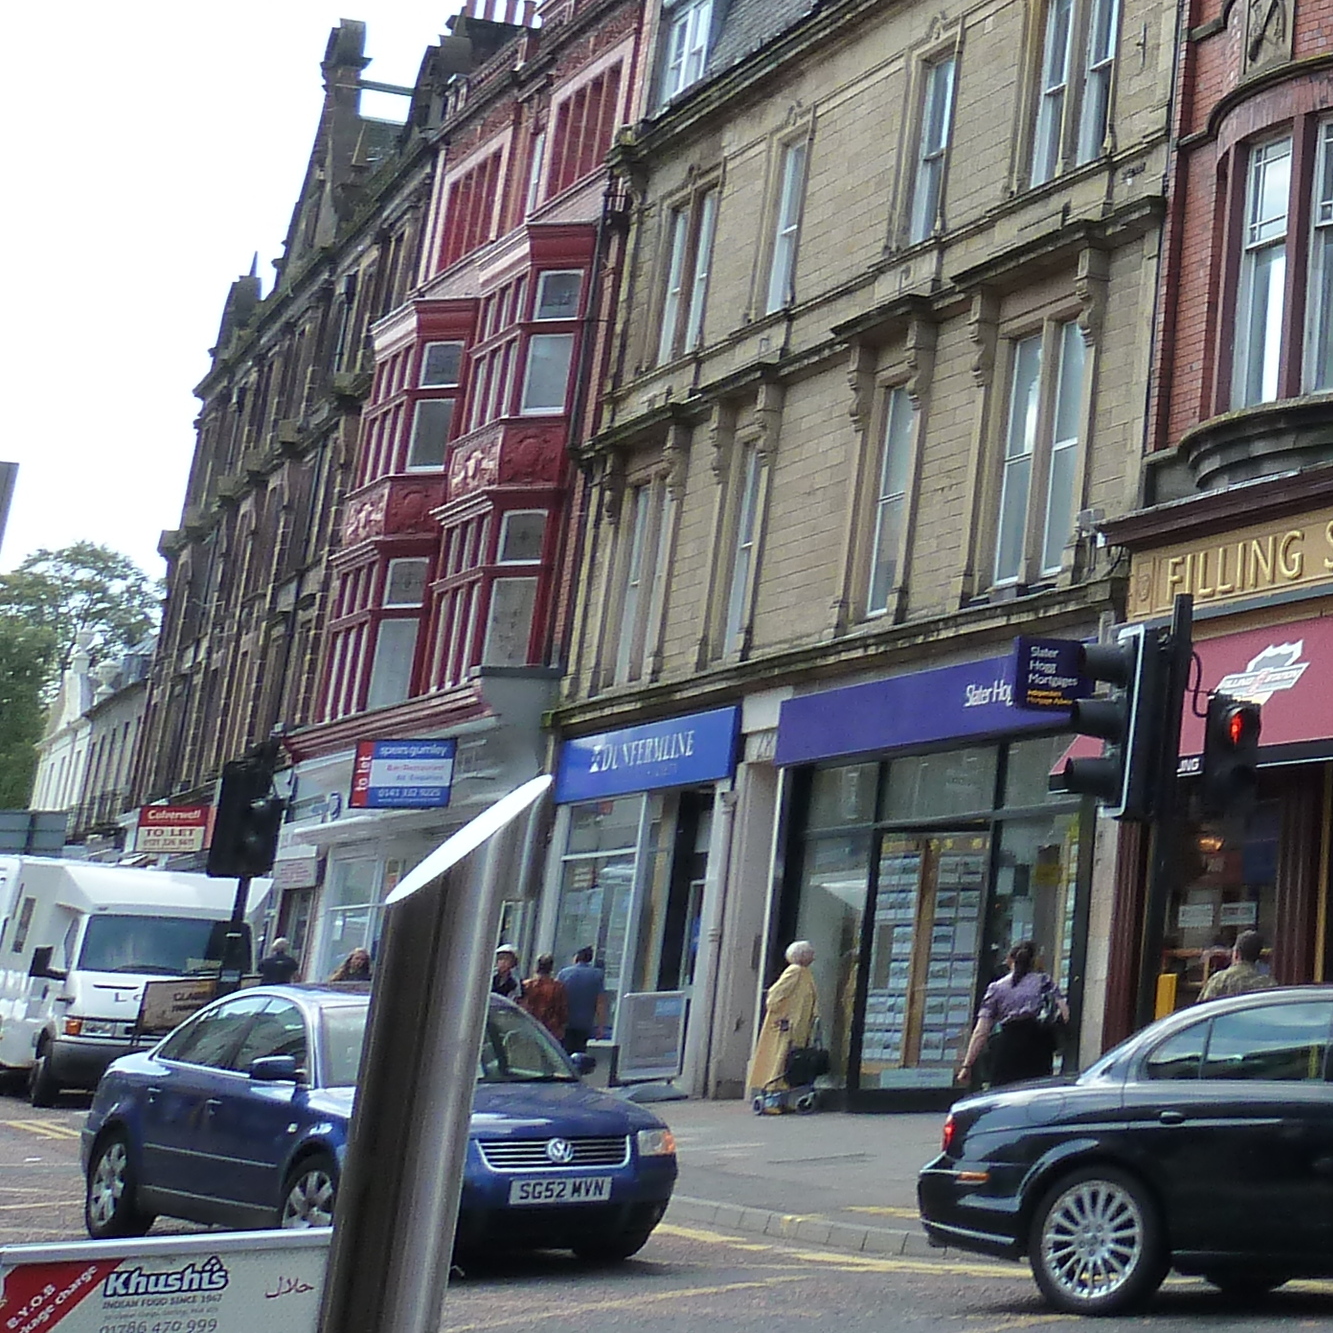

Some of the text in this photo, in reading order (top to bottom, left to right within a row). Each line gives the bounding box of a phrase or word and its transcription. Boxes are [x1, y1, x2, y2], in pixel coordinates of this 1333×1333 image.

[1166, 529, 1304, 603] FILLING
[1030, 645, 1060, 658] Slater
[1029, 660, 1058, 675] Hogg
[1028, 672, 1078, 689] Mortgages
[964, 684, 992, 708] Slater
[145, 828, 196, 837] TO LET
[519, 1178, 605, 1200] SG52 MVN
[140, 1297, 167, 1308] FOOD
[169, 1295, 198, 1306] SINCE
[100, 1318, 218, 1333] 01786 470 999
